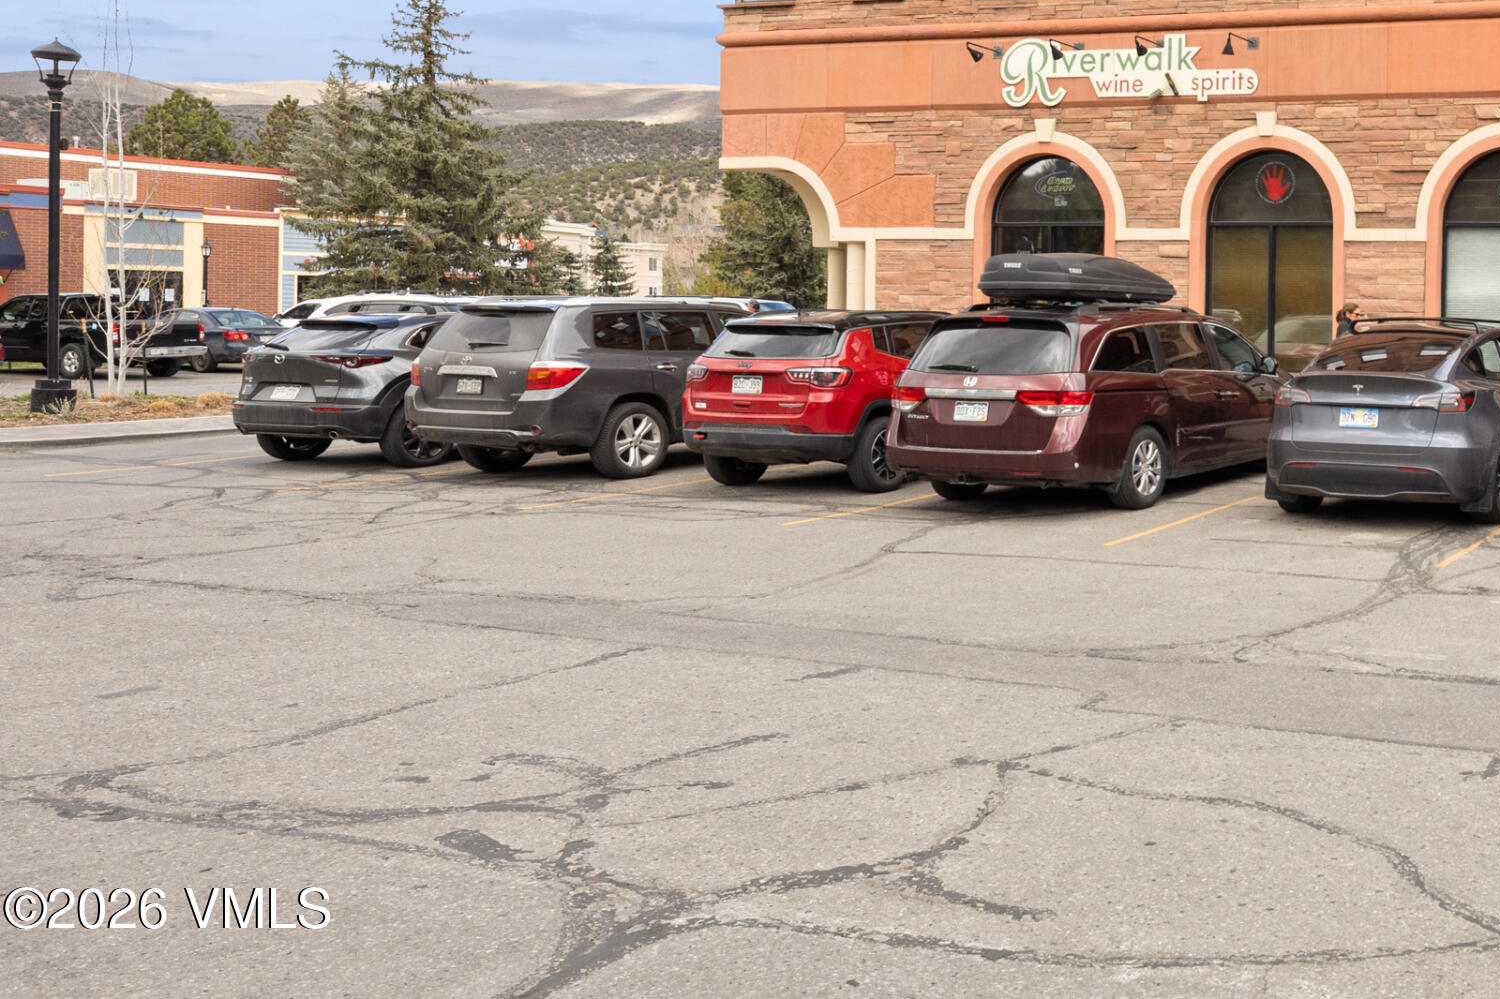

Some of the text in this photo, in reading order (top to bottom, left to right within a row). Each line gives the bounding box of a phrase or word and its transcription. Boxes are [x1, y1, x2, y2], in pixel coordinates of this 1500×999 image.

[1004, 37, 1193, 106] Riverwalk
[1096, 70, 1255, 97] wine spirits
